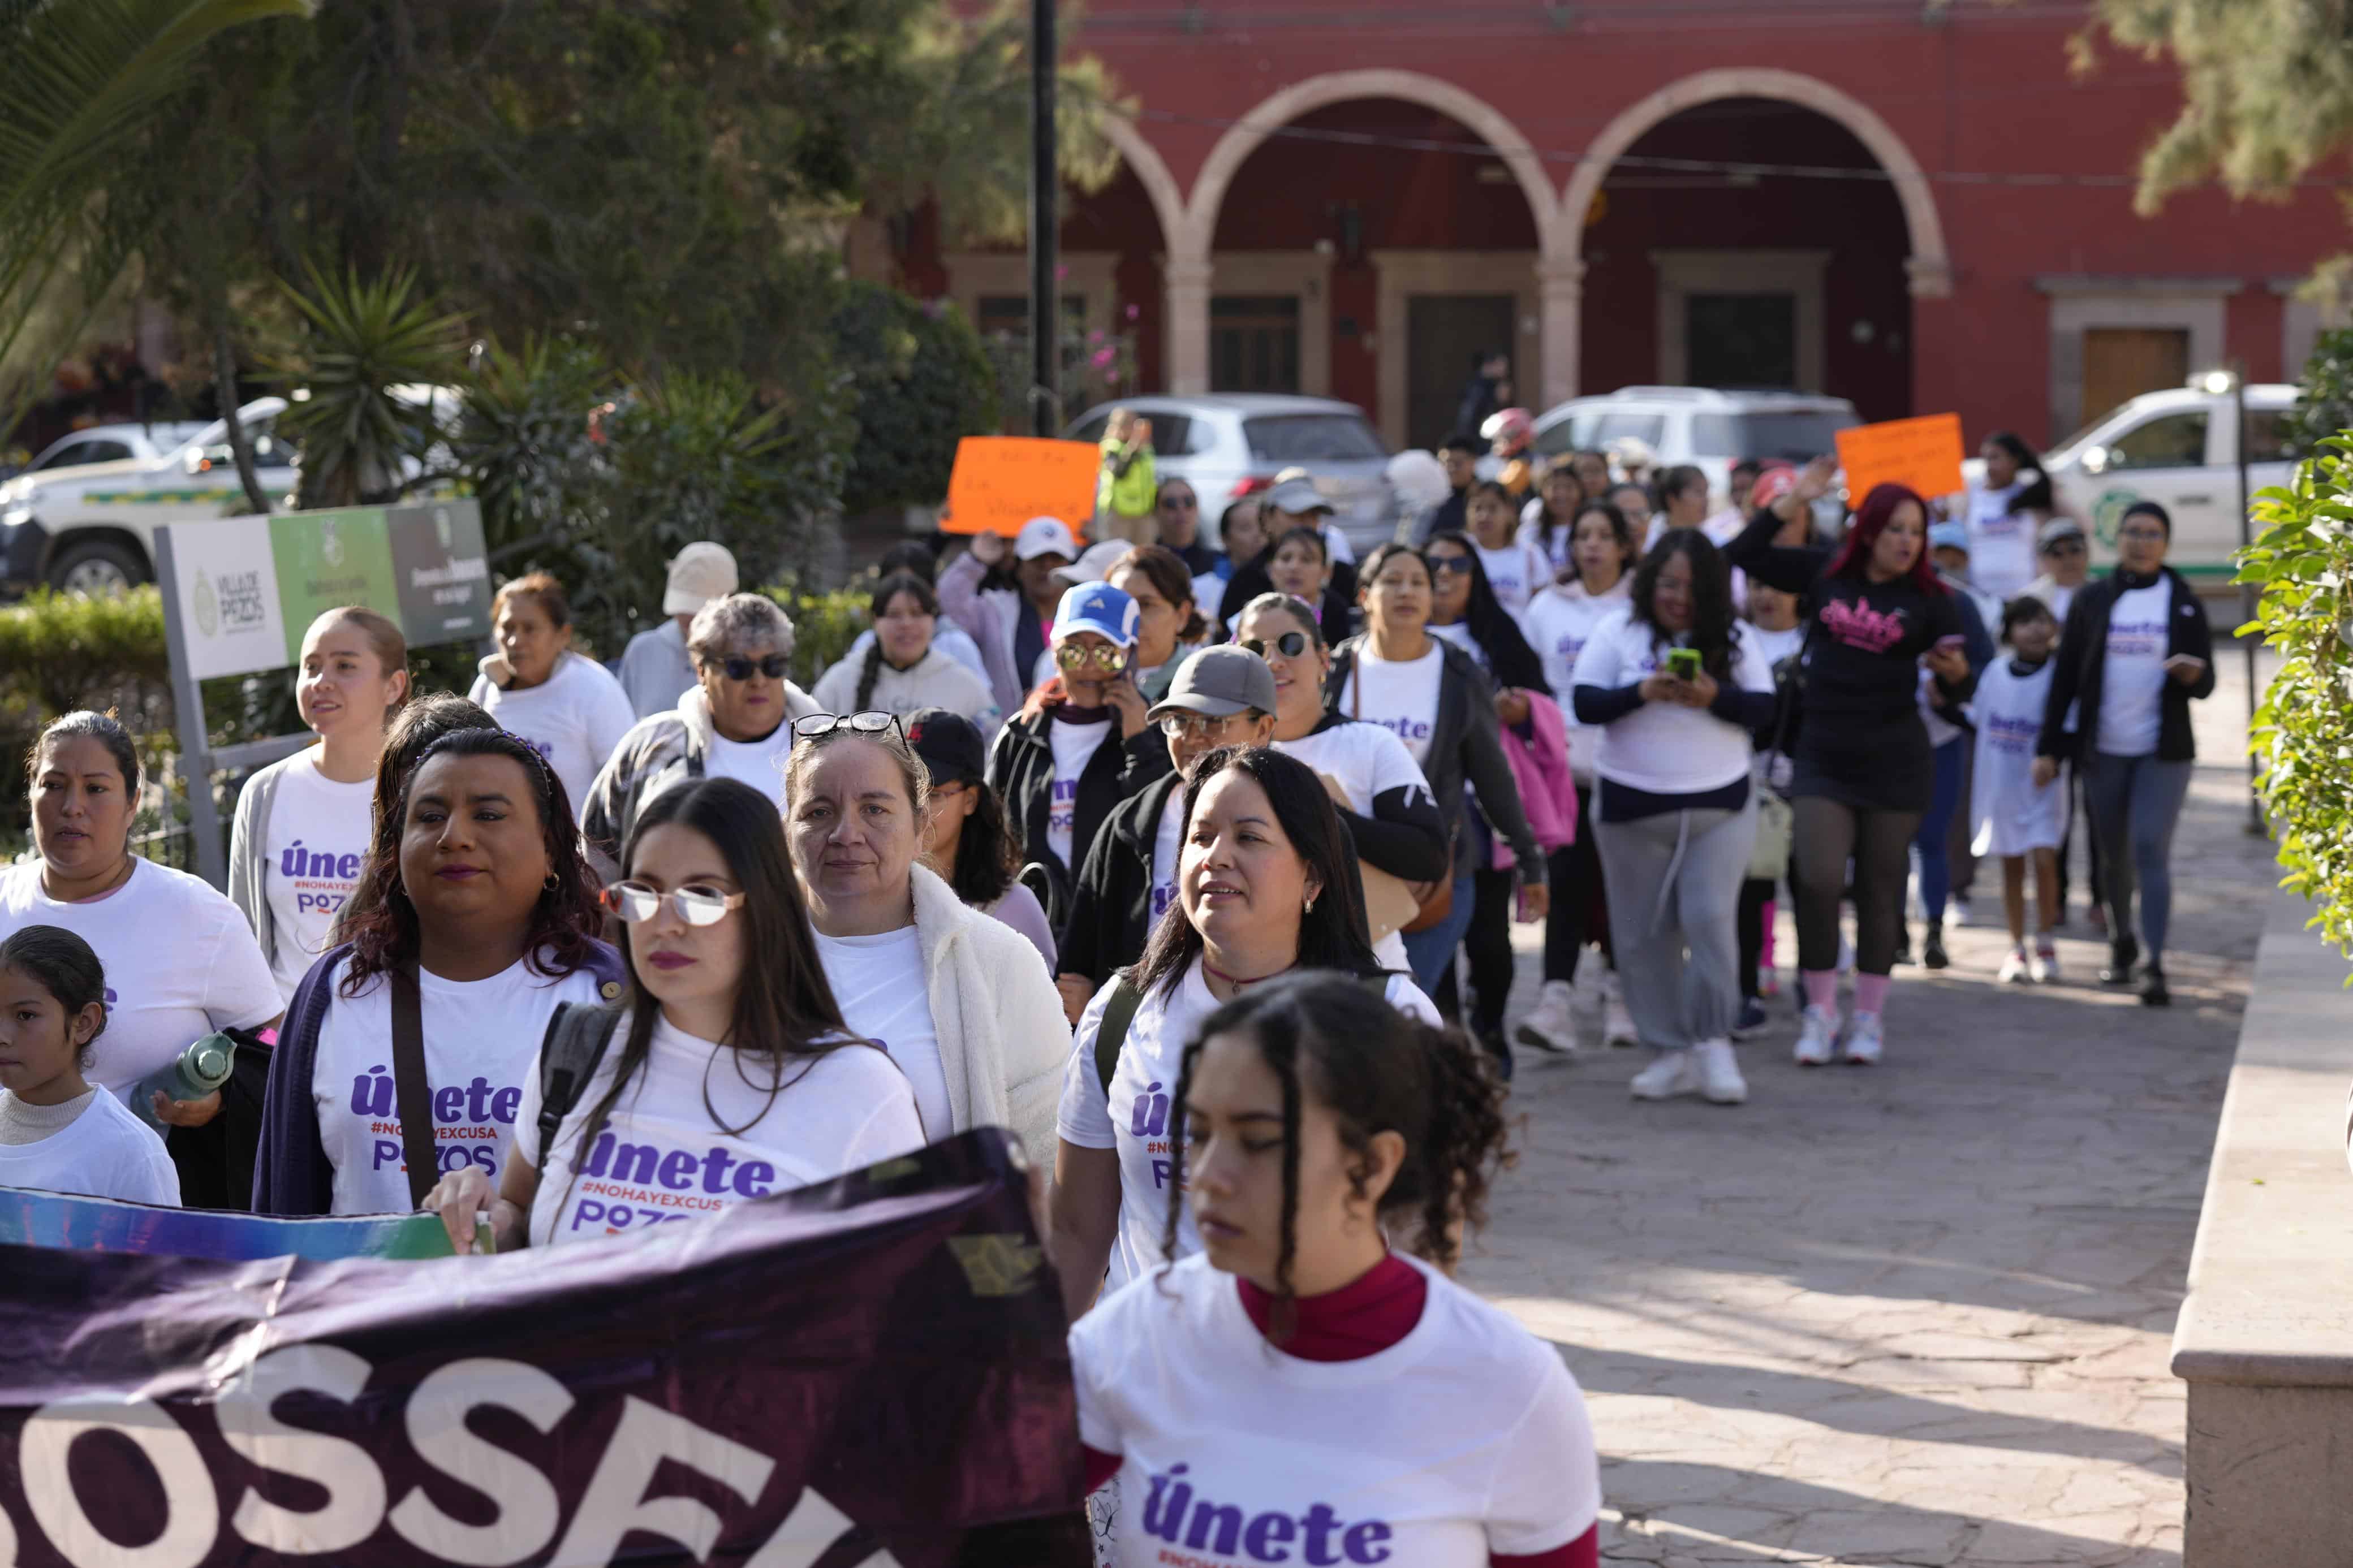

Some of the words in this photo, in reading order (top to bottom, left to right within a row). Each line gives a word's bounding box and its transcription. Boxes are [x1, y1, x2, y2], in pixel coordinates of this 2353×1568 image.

[351, 1065, 522, 1124] úete
[582, 1182, 722, 1211] #NOHAYEXCUS
[1143, 1462, 1391, 1566] únete
